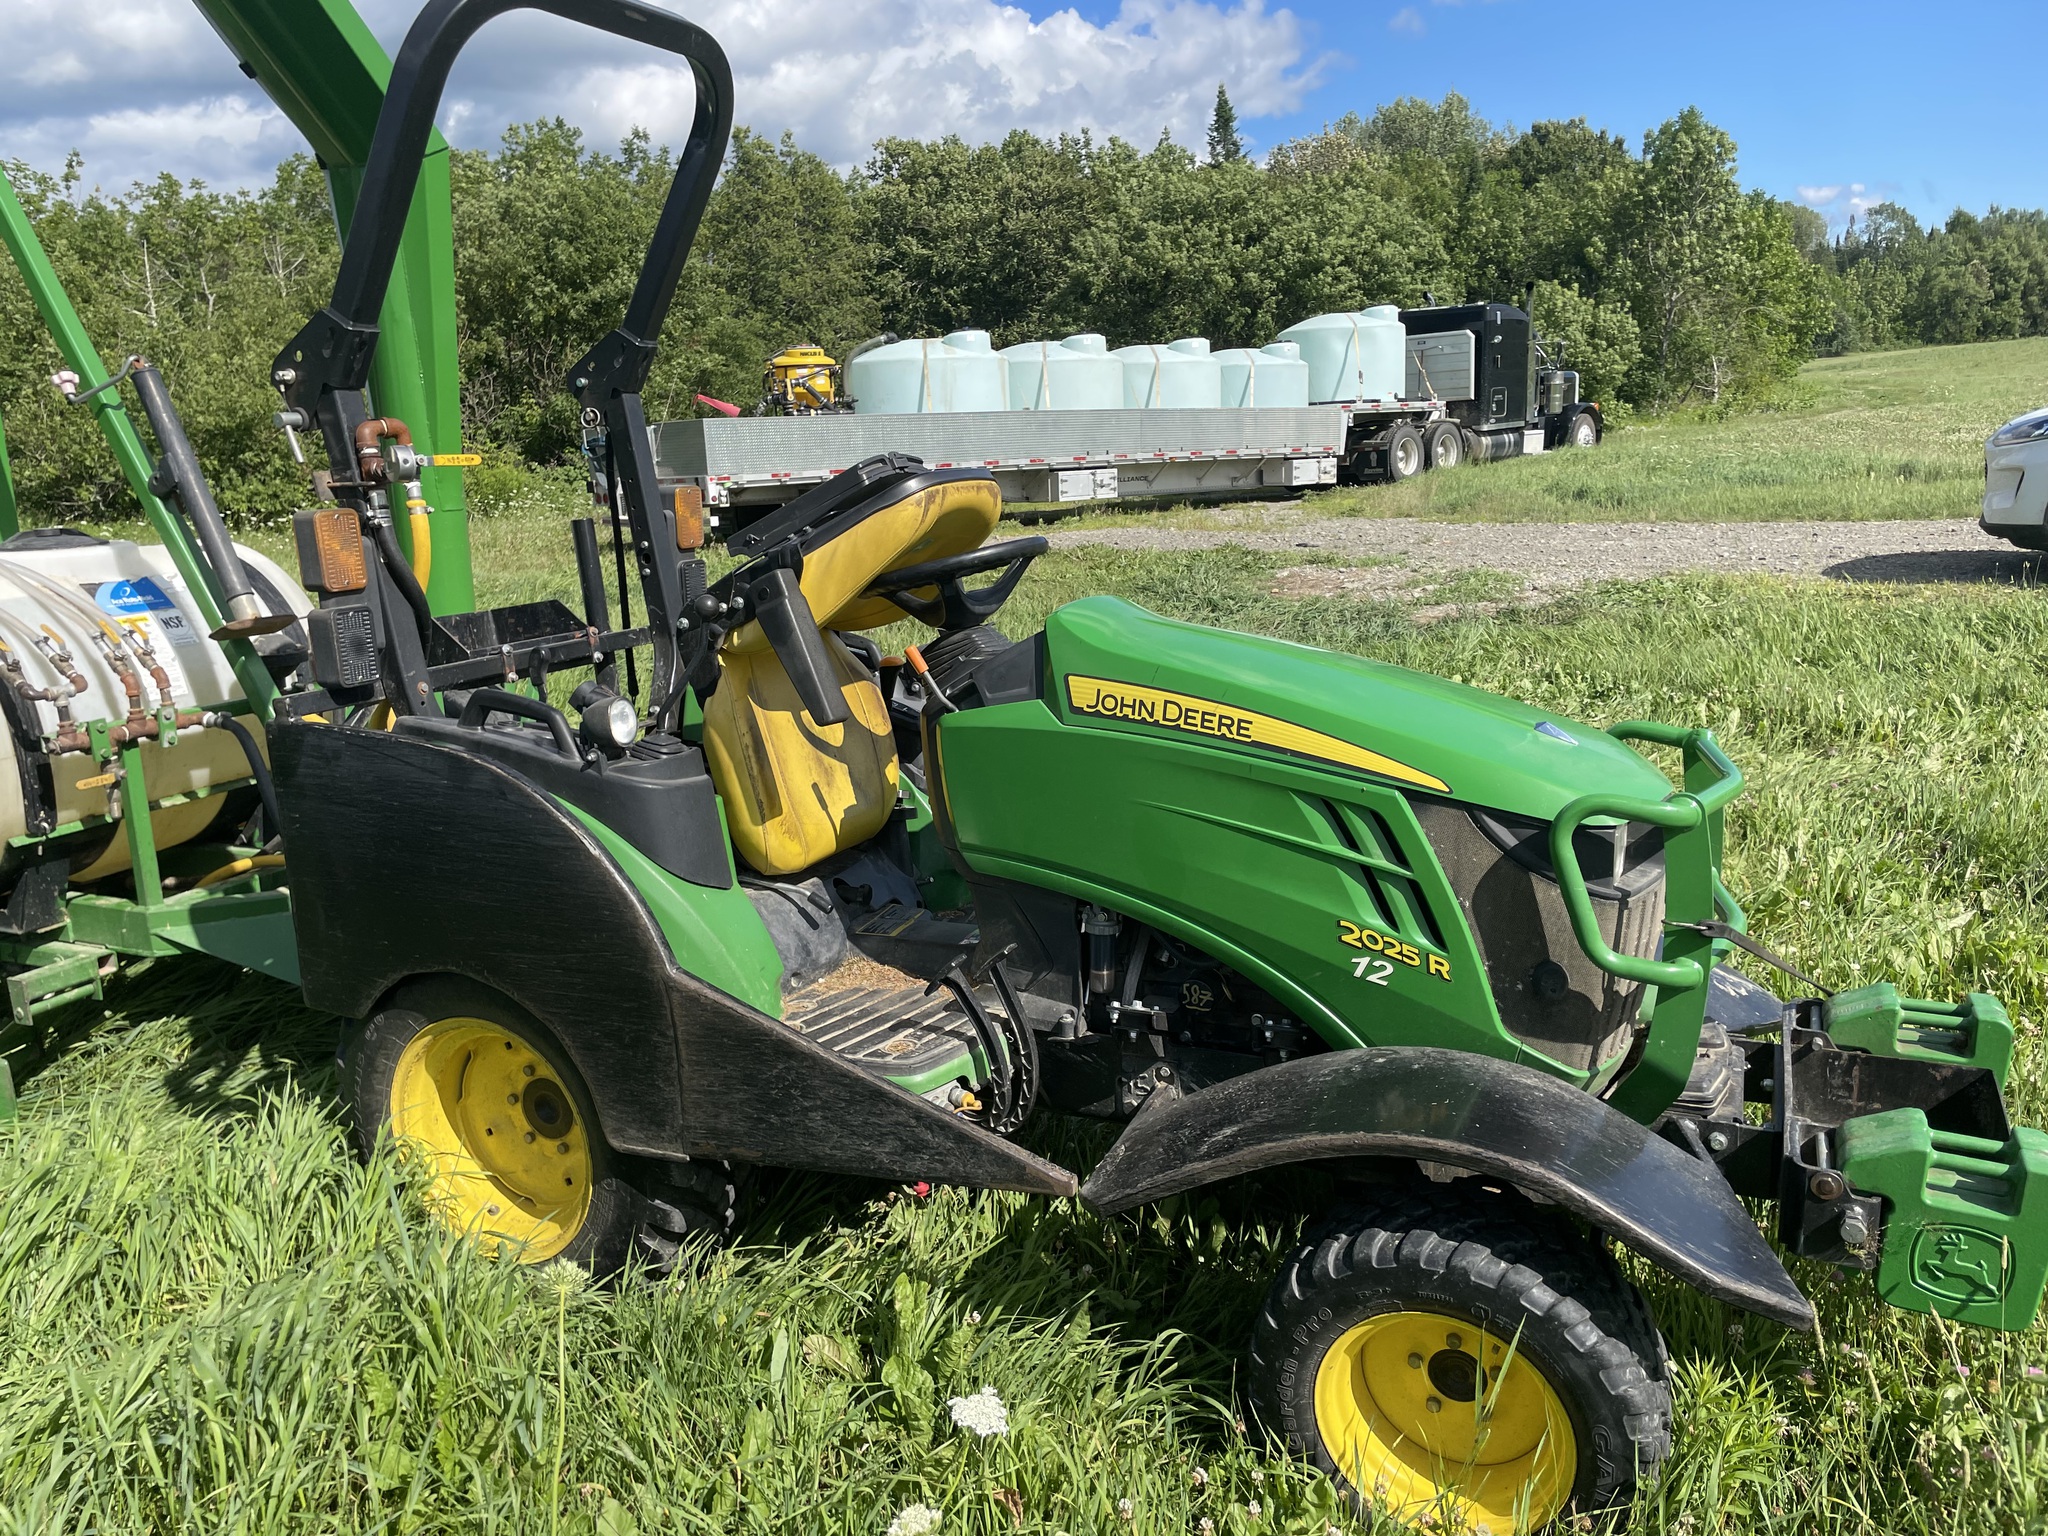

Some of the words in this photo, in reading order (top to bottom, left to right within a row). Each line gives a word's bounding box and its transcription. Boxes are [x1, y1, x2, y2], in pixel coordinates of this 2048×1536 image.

[161, 615, 184, 630] NSF
[1086, 688, 1156, 720] JOHN
[1162, 699, 1254, 740] DEERE
[1338, 919, 1421, 967] 2025
[1426, 952, 1452, 982] R
[1350, 956, 1390, 987] 12
[1182, 983, 1214, 1007] 587
